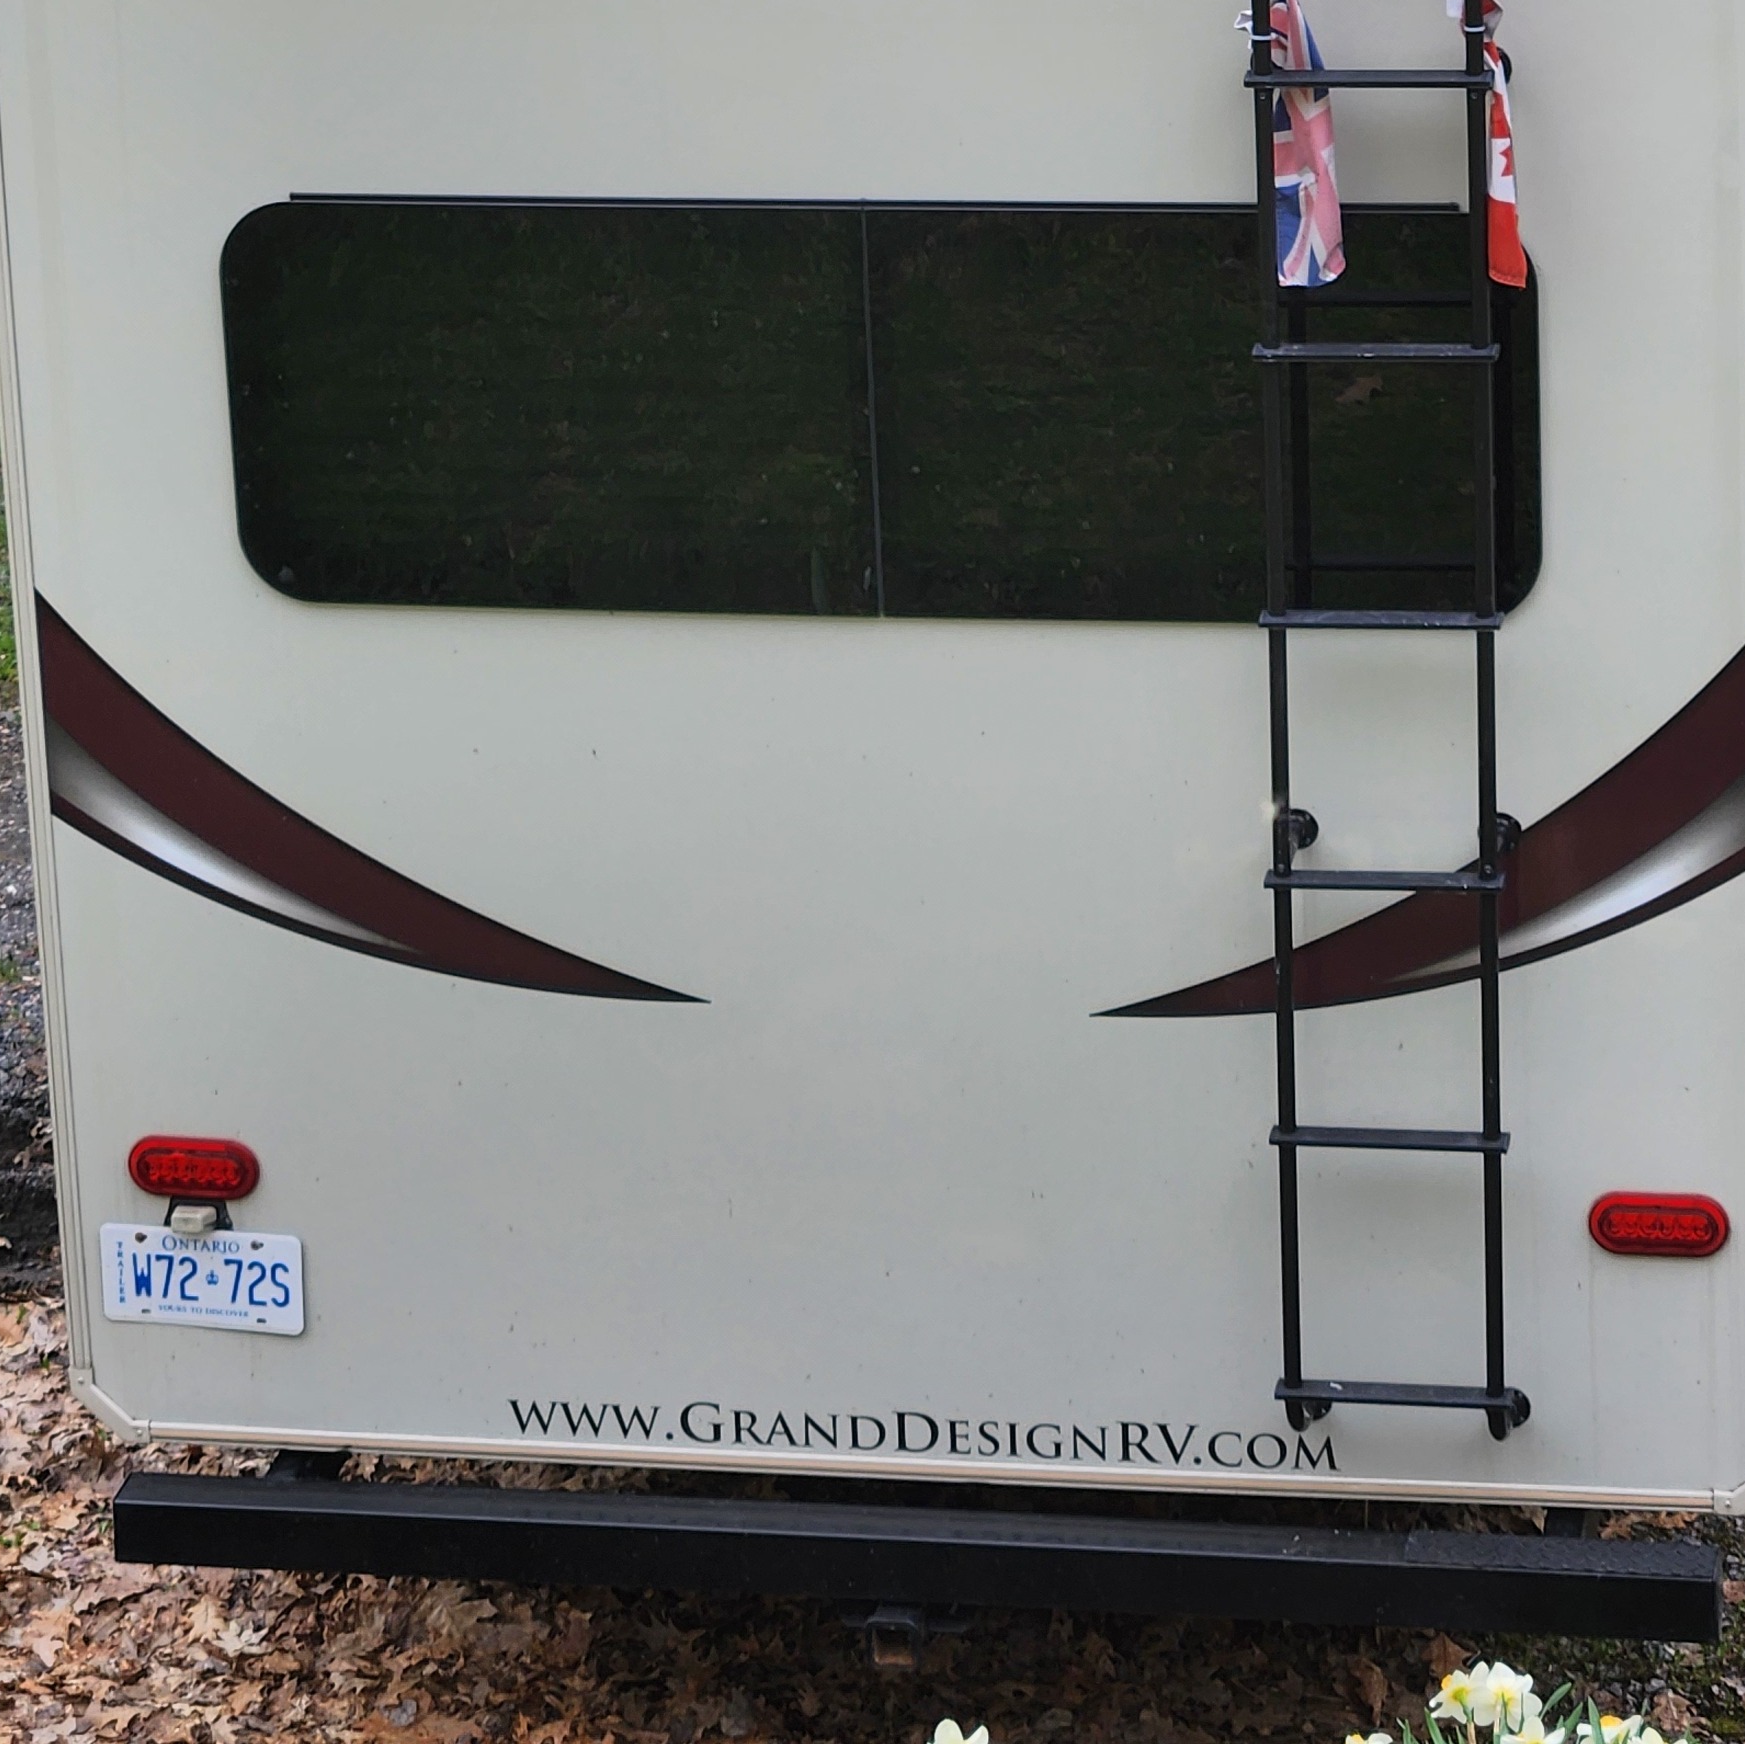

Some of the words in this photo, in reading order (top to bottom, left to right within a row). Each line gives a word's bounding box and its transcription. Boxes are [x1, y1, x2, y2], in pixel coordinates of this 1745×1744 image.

[161, 1234, 240, 1254] ONTARIO
[157, 1304, 188, 1314] YOURS
[190, 1306, 203, 1315] TO
[205, 1306, 250, 1318] DISCOVER
